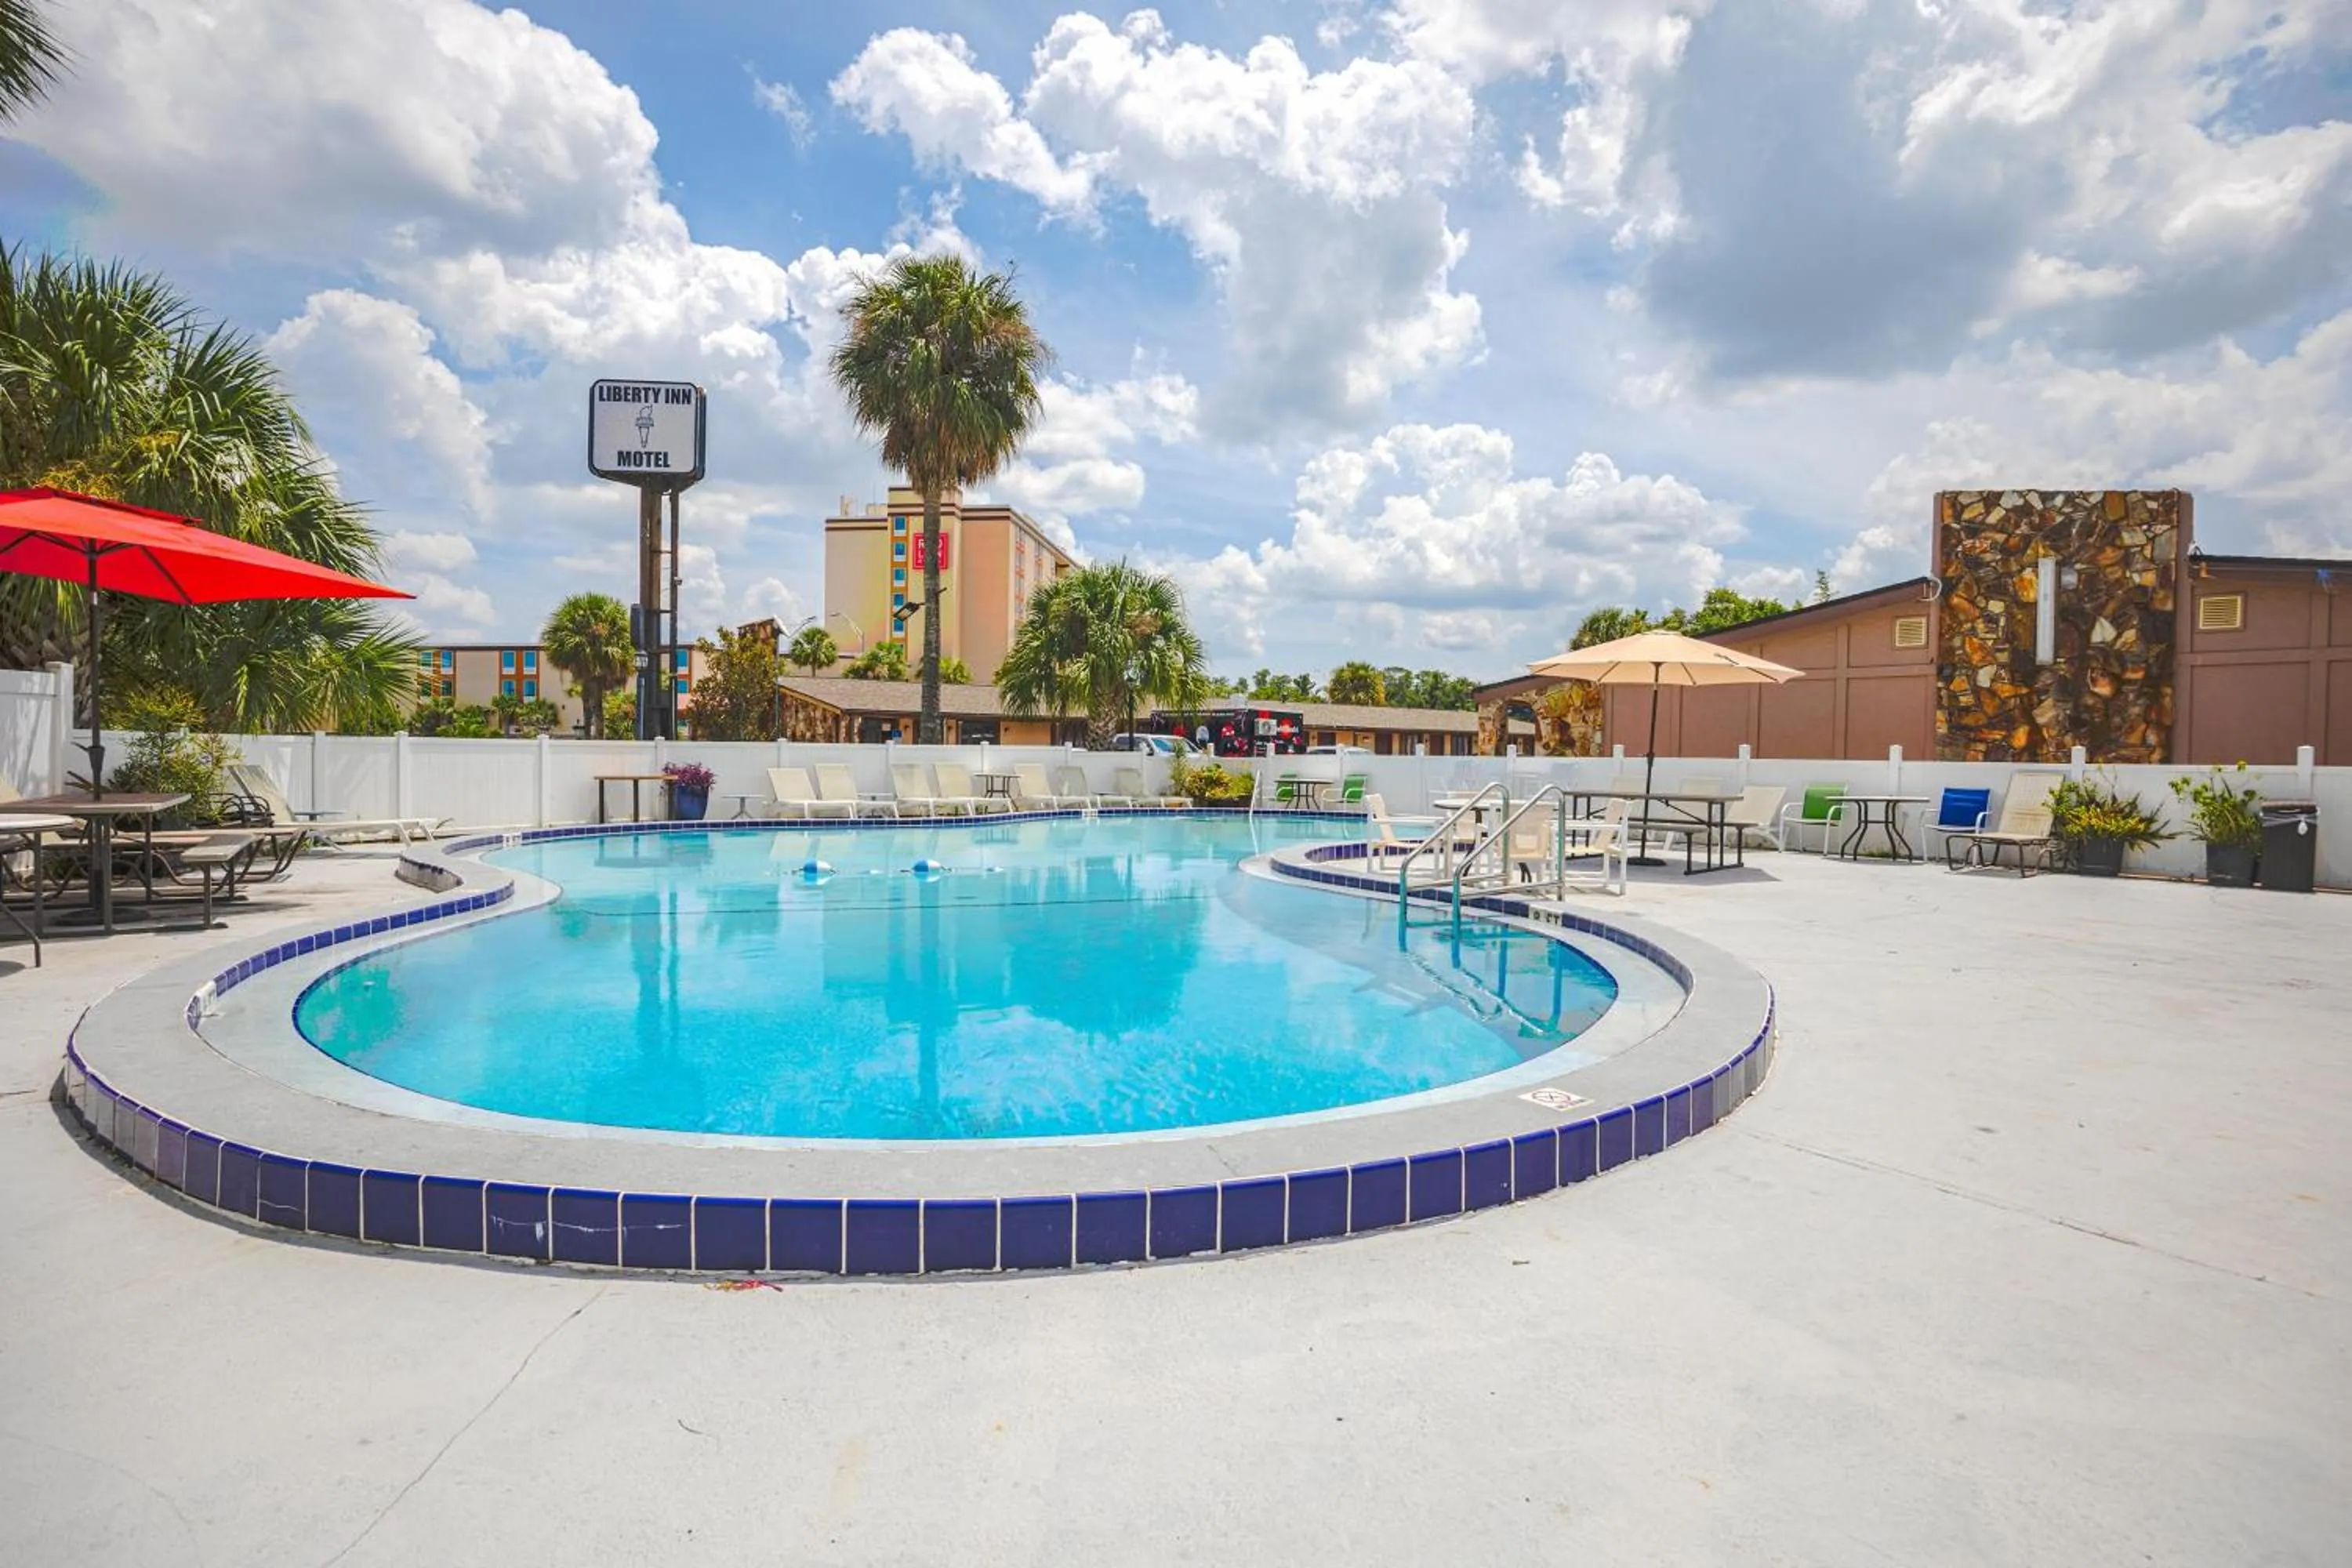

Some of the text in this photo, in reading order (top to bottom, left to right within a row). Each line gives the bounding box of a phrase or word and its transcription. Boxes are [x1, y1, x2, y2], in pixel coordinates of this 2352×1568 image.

[598, 386, 691, 405] LIBERTY INN
[617, 451, 670, 468] MOTEL
